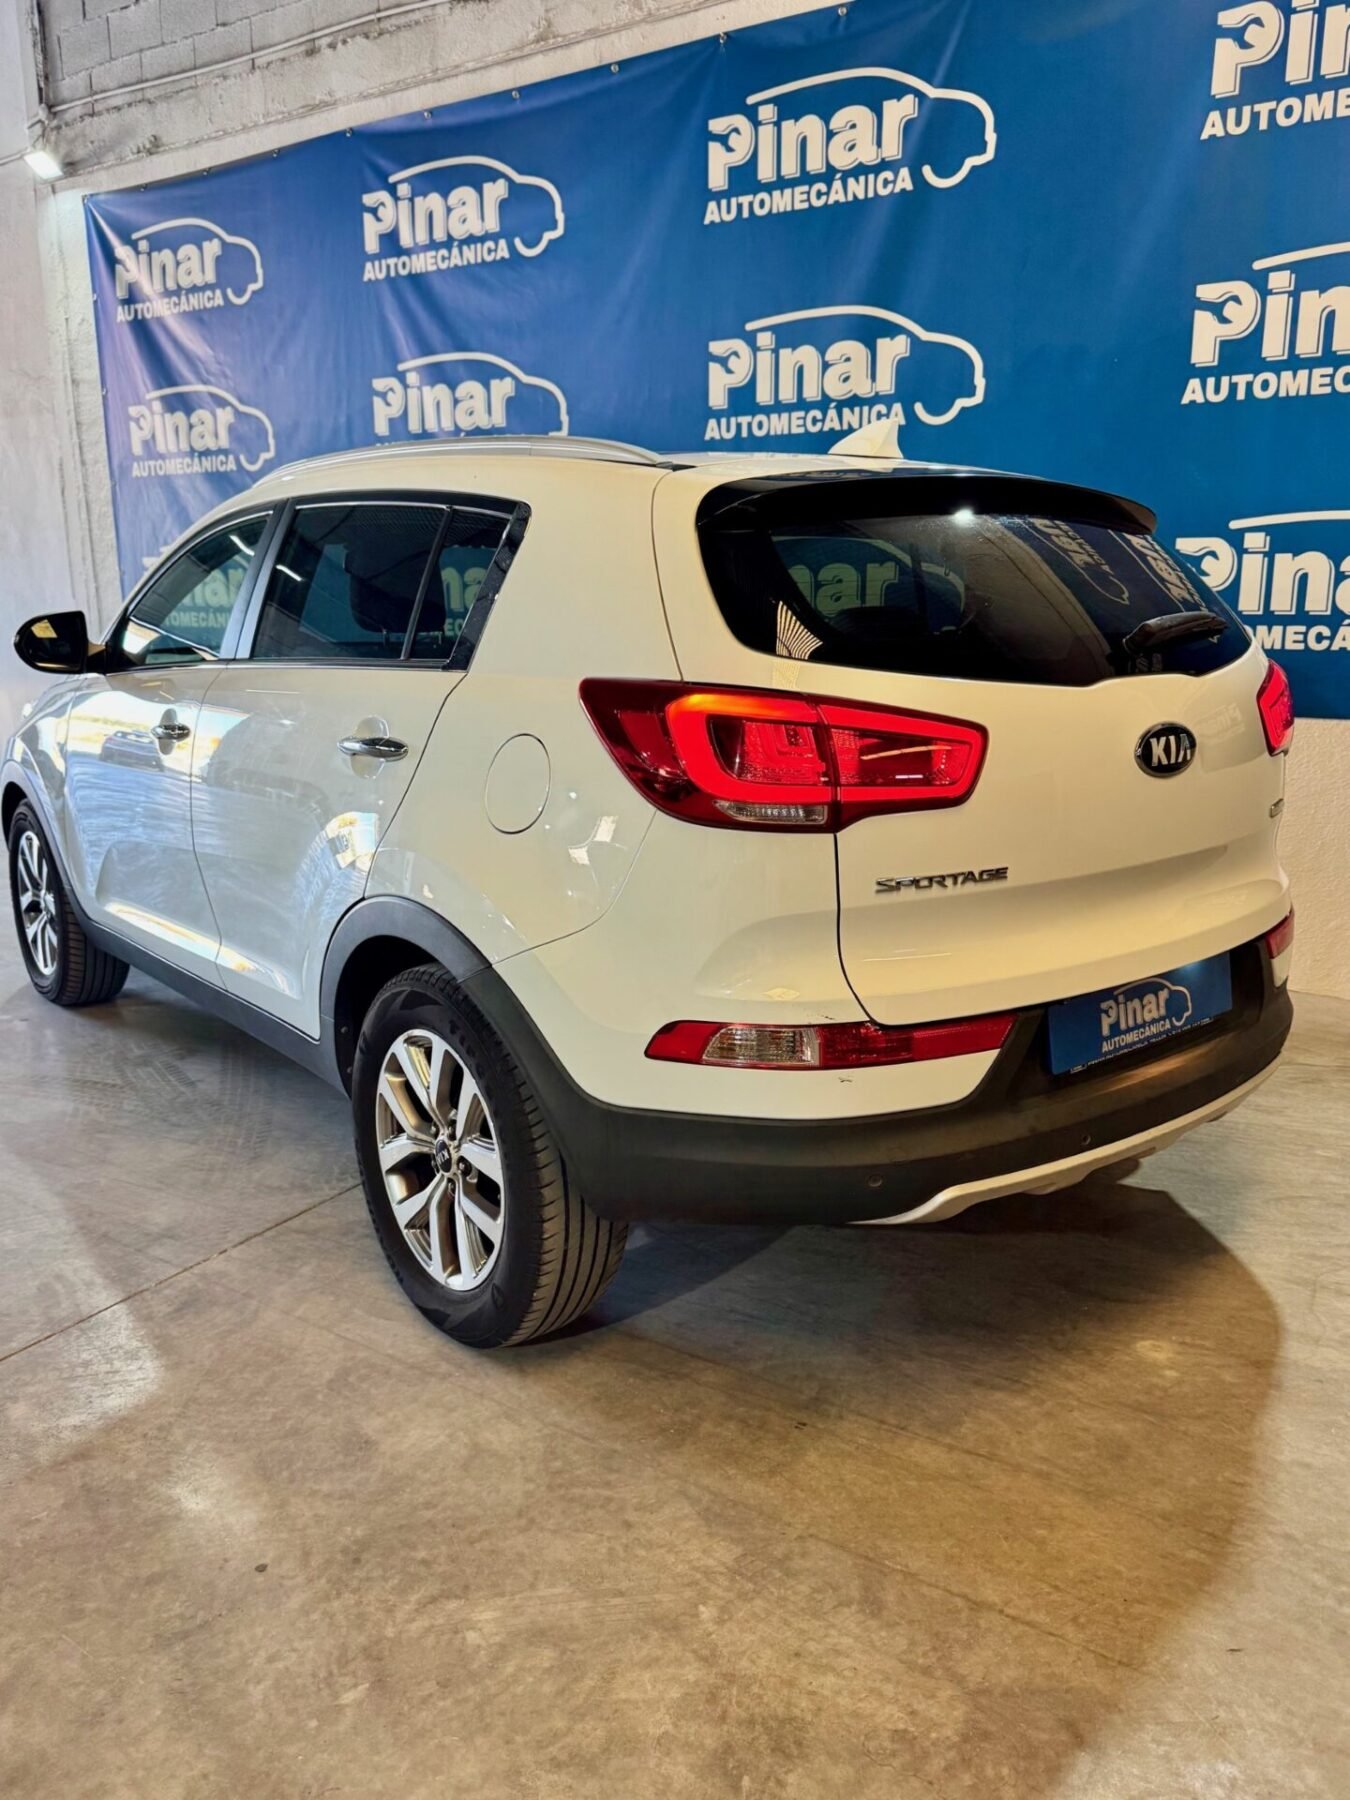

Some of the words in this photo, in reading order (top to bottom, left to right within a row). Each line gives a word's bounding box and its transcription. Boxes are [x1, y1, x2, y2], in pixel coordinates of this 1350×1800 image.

[708, 94, 918, 192] Pinar
[362, 178, 508, 254] Pinar
[703, 167, 914, 225] AUTOMECÁNICA
[115, 238, 222, 299] Pinar
[363, 239, 510, 282] AUTOMECÁNICA
[116, 288, 224, 323] AUTOMECÁNICA
[1190, 270, 1350, 367] Pin
[708, 331, 910, 409] Pinar
[1180, 365, 1350, 405] AUTOMEC
[128, 400, 235, 456] Pinar
[372, 371, 515, 436] Pinar
[132, 452, 237, 478] AUTOMECÁNICA
[1175, 532, 1350, 615] Pin
[1149, 733, 1191, 767] KIA
[875, 866, 1009, 894] SPORTAGE
[1100, 987, 1169, 1037] Pinar
[1102, 1018, 1172, 1053] AUTOMECÁNICA
